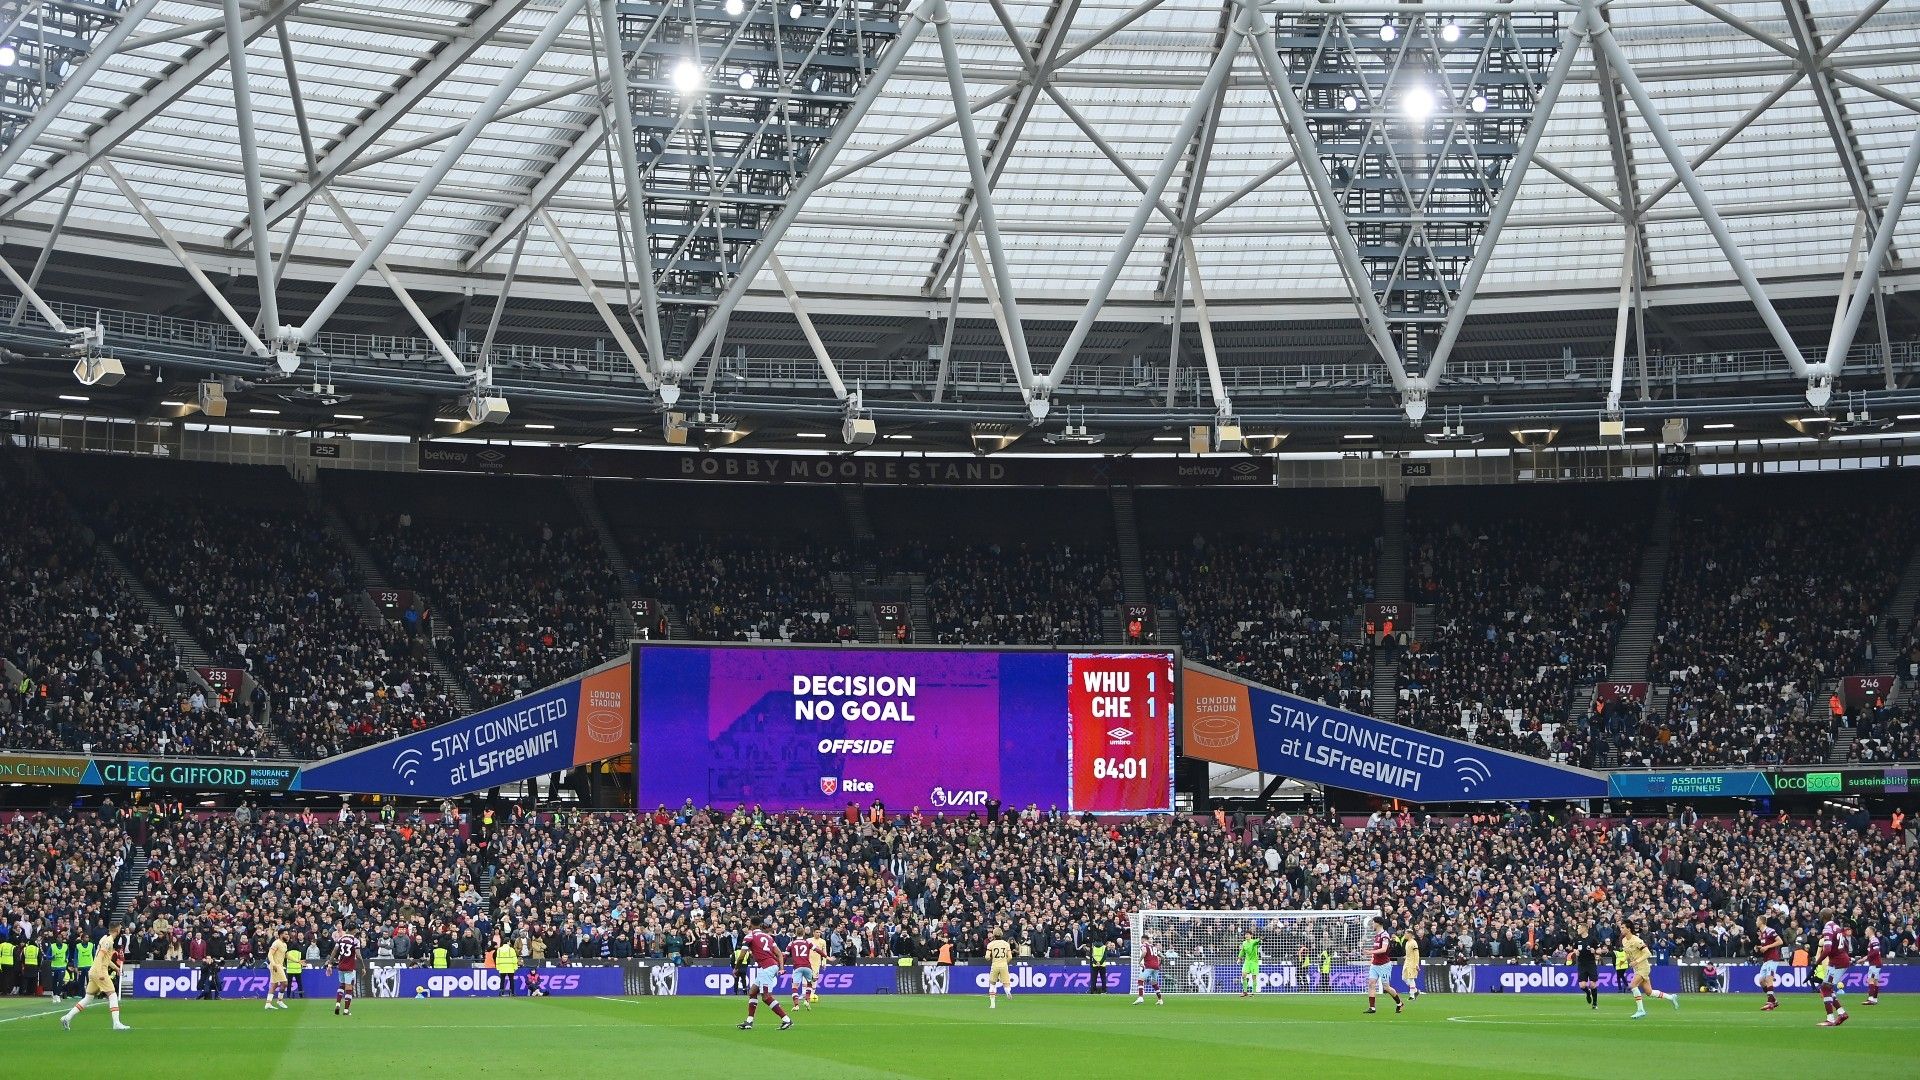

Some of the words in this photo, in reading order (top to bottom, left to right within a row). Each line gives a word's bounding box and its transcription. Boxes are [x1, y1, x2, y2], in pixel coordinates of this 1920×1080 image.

[316, 446, 335, 455] 252
[424, 449, 468, 463] betway
[681, 457, 780, 476] BOBBY
[790, 461, 898, 478] MOORE
[908, 462, 1006, 480] STAND
[1178, 465, 1222, 477] betway
[1406, 465, 1426, 474] 248
[381, 592, 398, 601] 252
[631, 600, 648, 609] 251
[880, 605, 897, 614] 250
[1129, 606, 1146, 615] 249
[1380, 605, 1398, 614] 248
[209, 671, 227, 681] 253
[1083, 671, 1130, 693] WHU
[1146, 671, 1155, 693] 1
[793, 675, 916, 697] DECISION
[1613, 685, 1632, 694] 247
[1860, 678, 1879, 688] 246
[590, 690, 621, 699] LONDON
[1196, 696, 1236, 704] LONDON
[590, 698, 621, 708] STADIUM
[1091, 696, 1132, 718] CHE
[1146, 696, 1155, 718] 1
[1196, 704, 1236, 712] STADIUM
[795, 700, 835, 721] NO
[841, 700, 916, 722] GOAL
[431, 730, 470, 762] STAY
[475, 697, 567, 747] CONNECTED
[1269, 703, 1319, 733] STAY
[1321, 717, 1445, 769] CONNECTED
[817, 739, 895, 754] OFFSIDE
[450, 763, 466, 786] at
[470, 730, 559, 779] LSFreeWIFI
[1280, 734, 1301, 758] at
[1303, 743, 1421, 792] LSFreeWIFI
[17, 764, 80, 777] CLEANING
[104, 764, 164, 783] CLEGG
[170, 767, 247, 785] GIFFORD
[250, 769, 290, 778] INSURANCE
[1093, 757, 1147, 779] 84:01
[250, 778, 279, 786] BROKERS
[842, 778, 874, 792] Rice
[1671, 776, 1723, 785] ASSOCIATE
[1671, 784, 1721, 793] PARTNERS
[947, 790, 988, 806] VAR
[339, 942, 353, 957] 33
[760, 936, 771, 952] 2
[793, 944, 808, 957] 12
[993, 947, 1006, 959] 23
[427, 969, 501, 998] apollo
[1500, 966, 1569, 993] apollo
